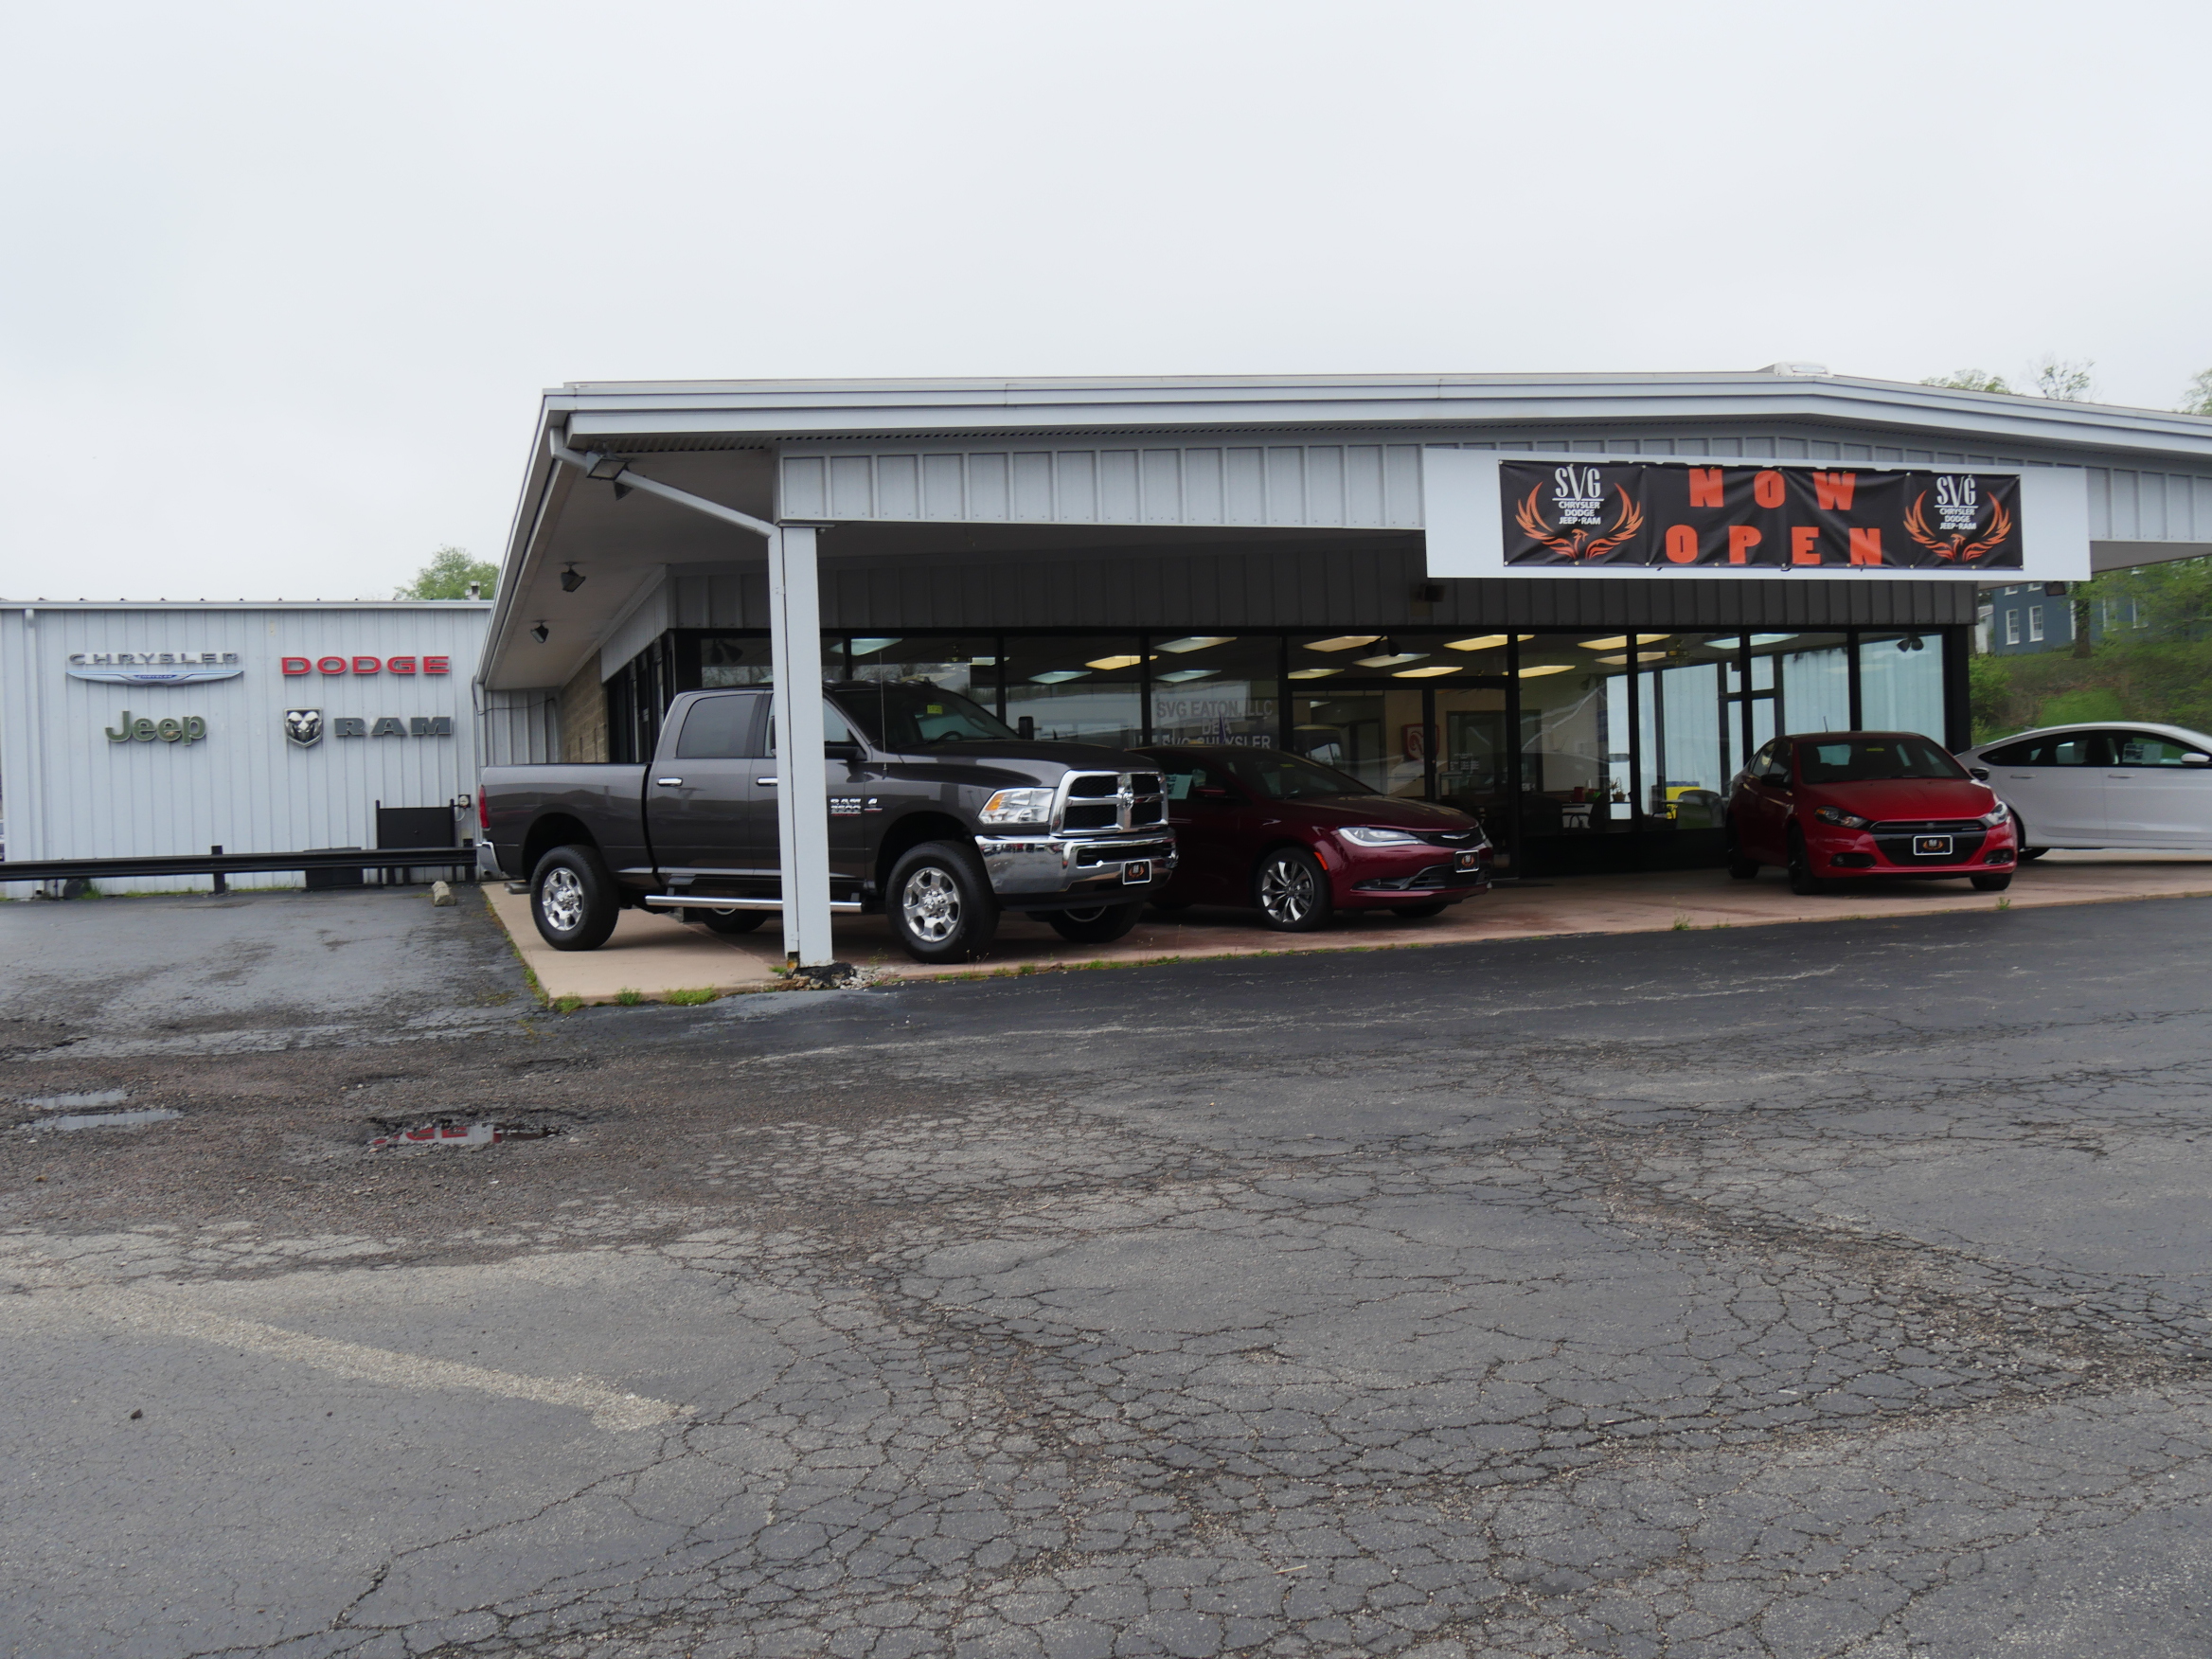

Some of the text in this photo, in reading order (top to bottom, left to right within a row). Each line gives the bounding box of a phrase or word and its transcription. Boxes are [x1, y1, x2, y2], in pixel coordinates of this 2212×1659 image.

[1554, 466, 1601, 501] SVG
[1688, 468, 1856, 510] NOW
[1936, 475, 1976, 508] SVG
[1559, 501, 1600, 509] CHRYSLER
[1666, 525, 1882, 565] OPEN
[69, 652, 240, 665] CHRYSLER
[281, 656, 451, 675] DODGE
[1157, 701, 1186, 718] SVG
[1245, 700, 1273, 716] LLC
[105, 710, 206, 746] Jeep
[334, 717, 452, 736] RAM
